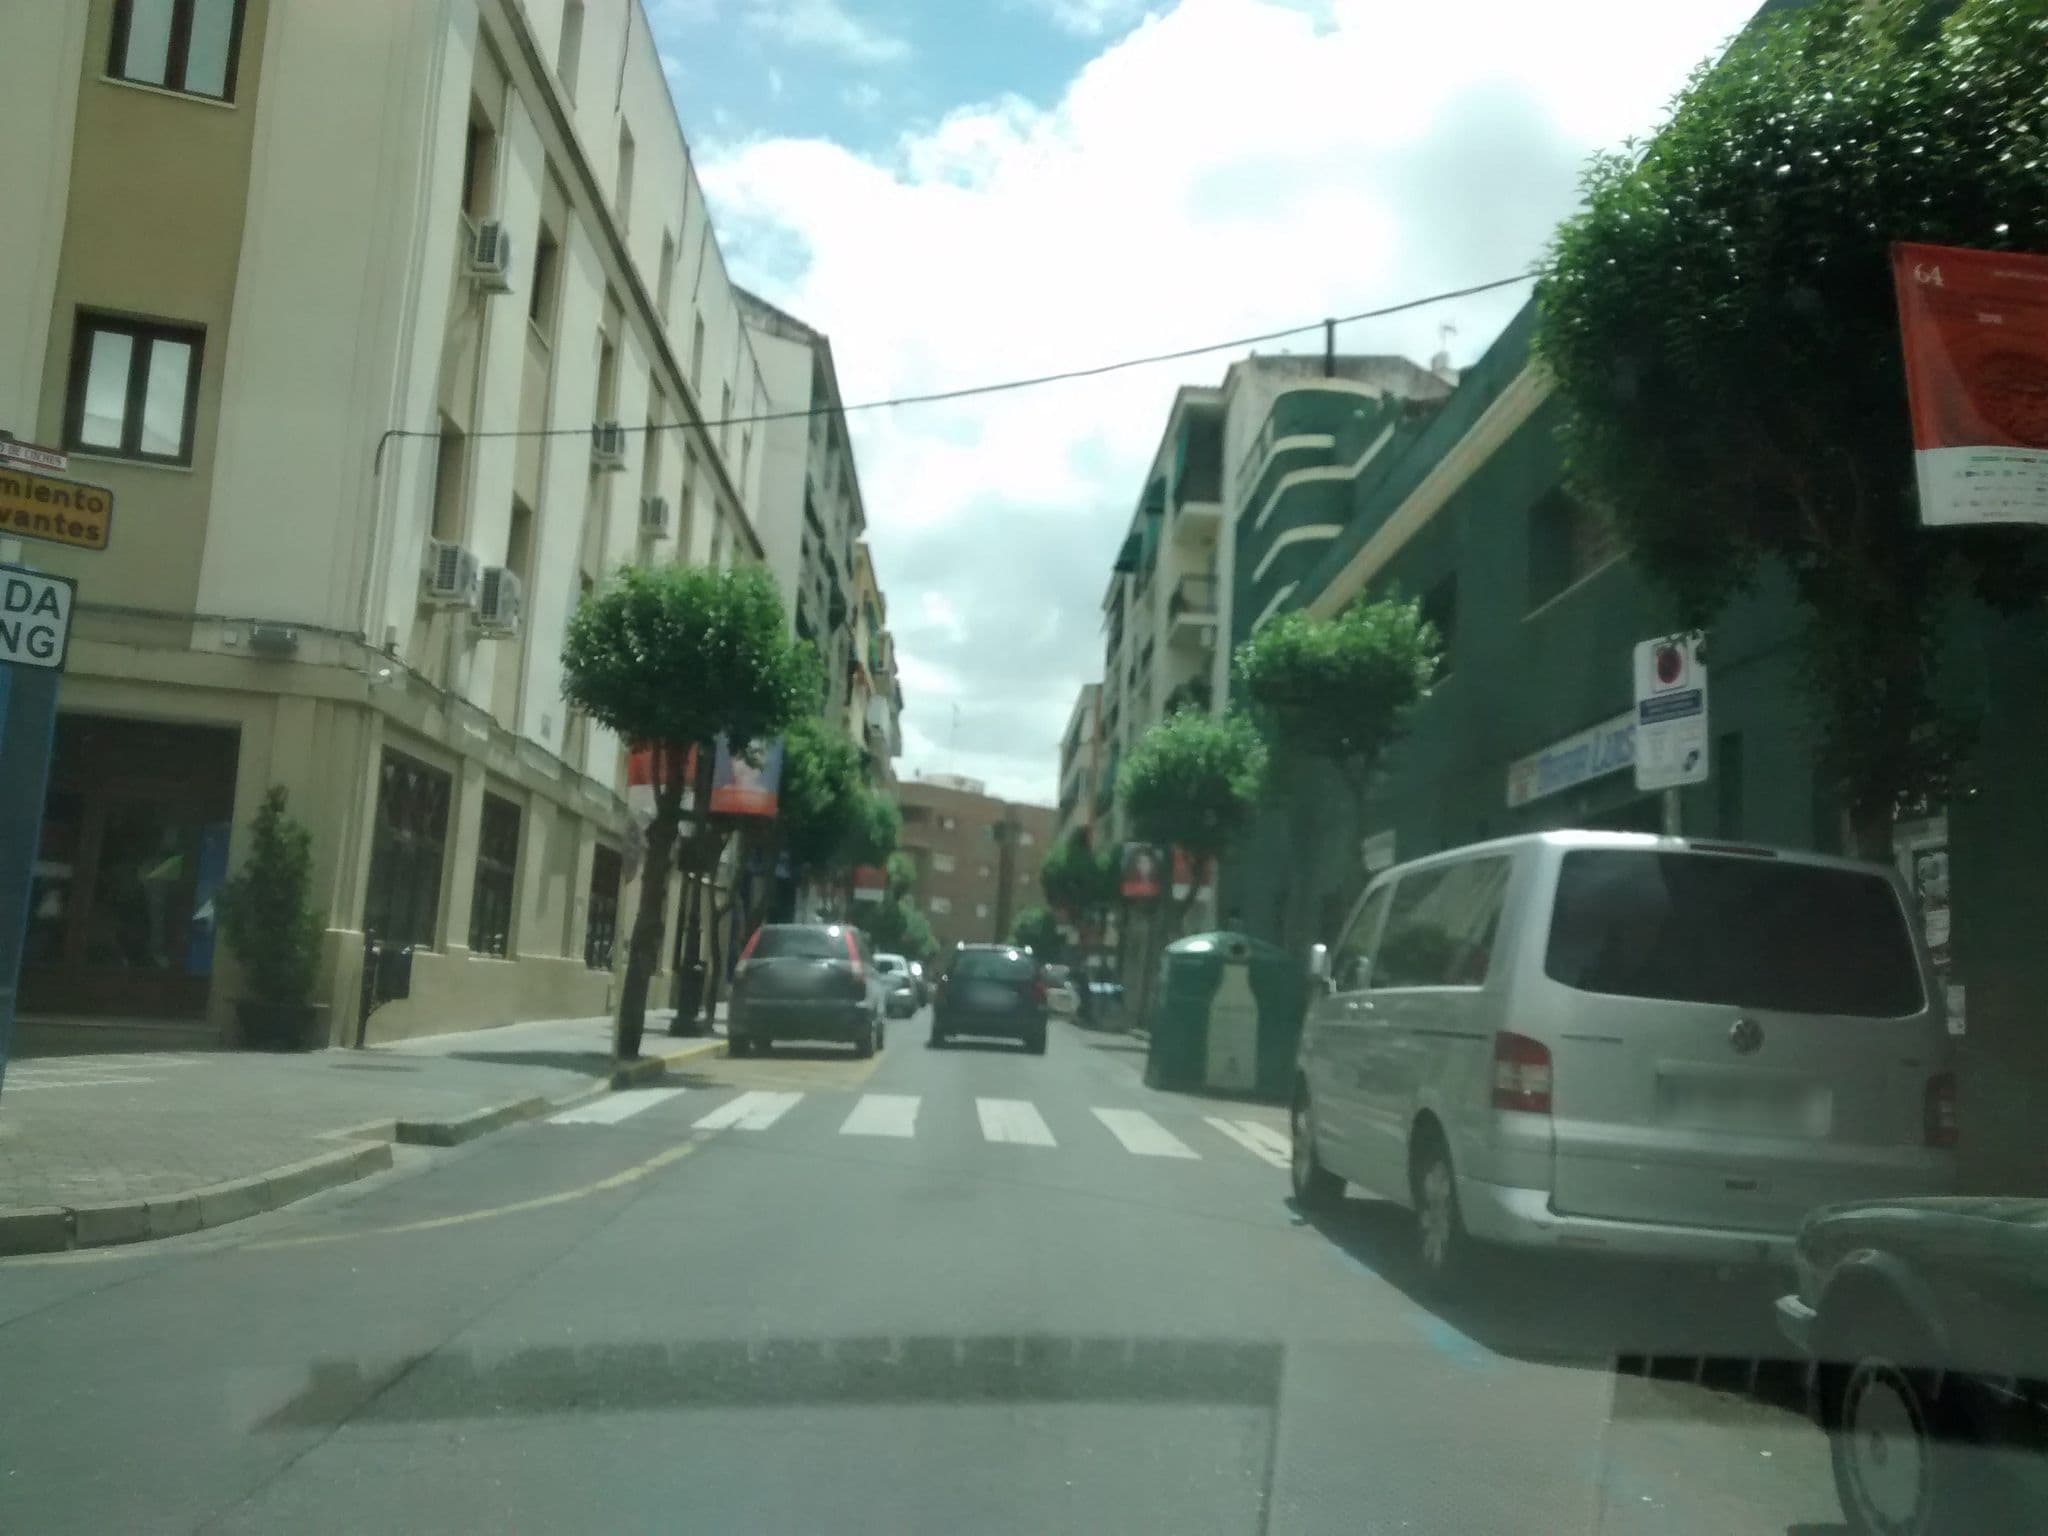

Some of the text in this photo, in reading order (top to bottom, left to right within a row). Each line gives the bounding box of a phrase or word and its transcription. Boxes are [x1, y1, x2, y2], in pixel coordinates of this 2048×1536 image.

[0, 477, 104, 513] miento
[0, 507, 100, 540] vantes
[4, 578, 61, 620] DA
